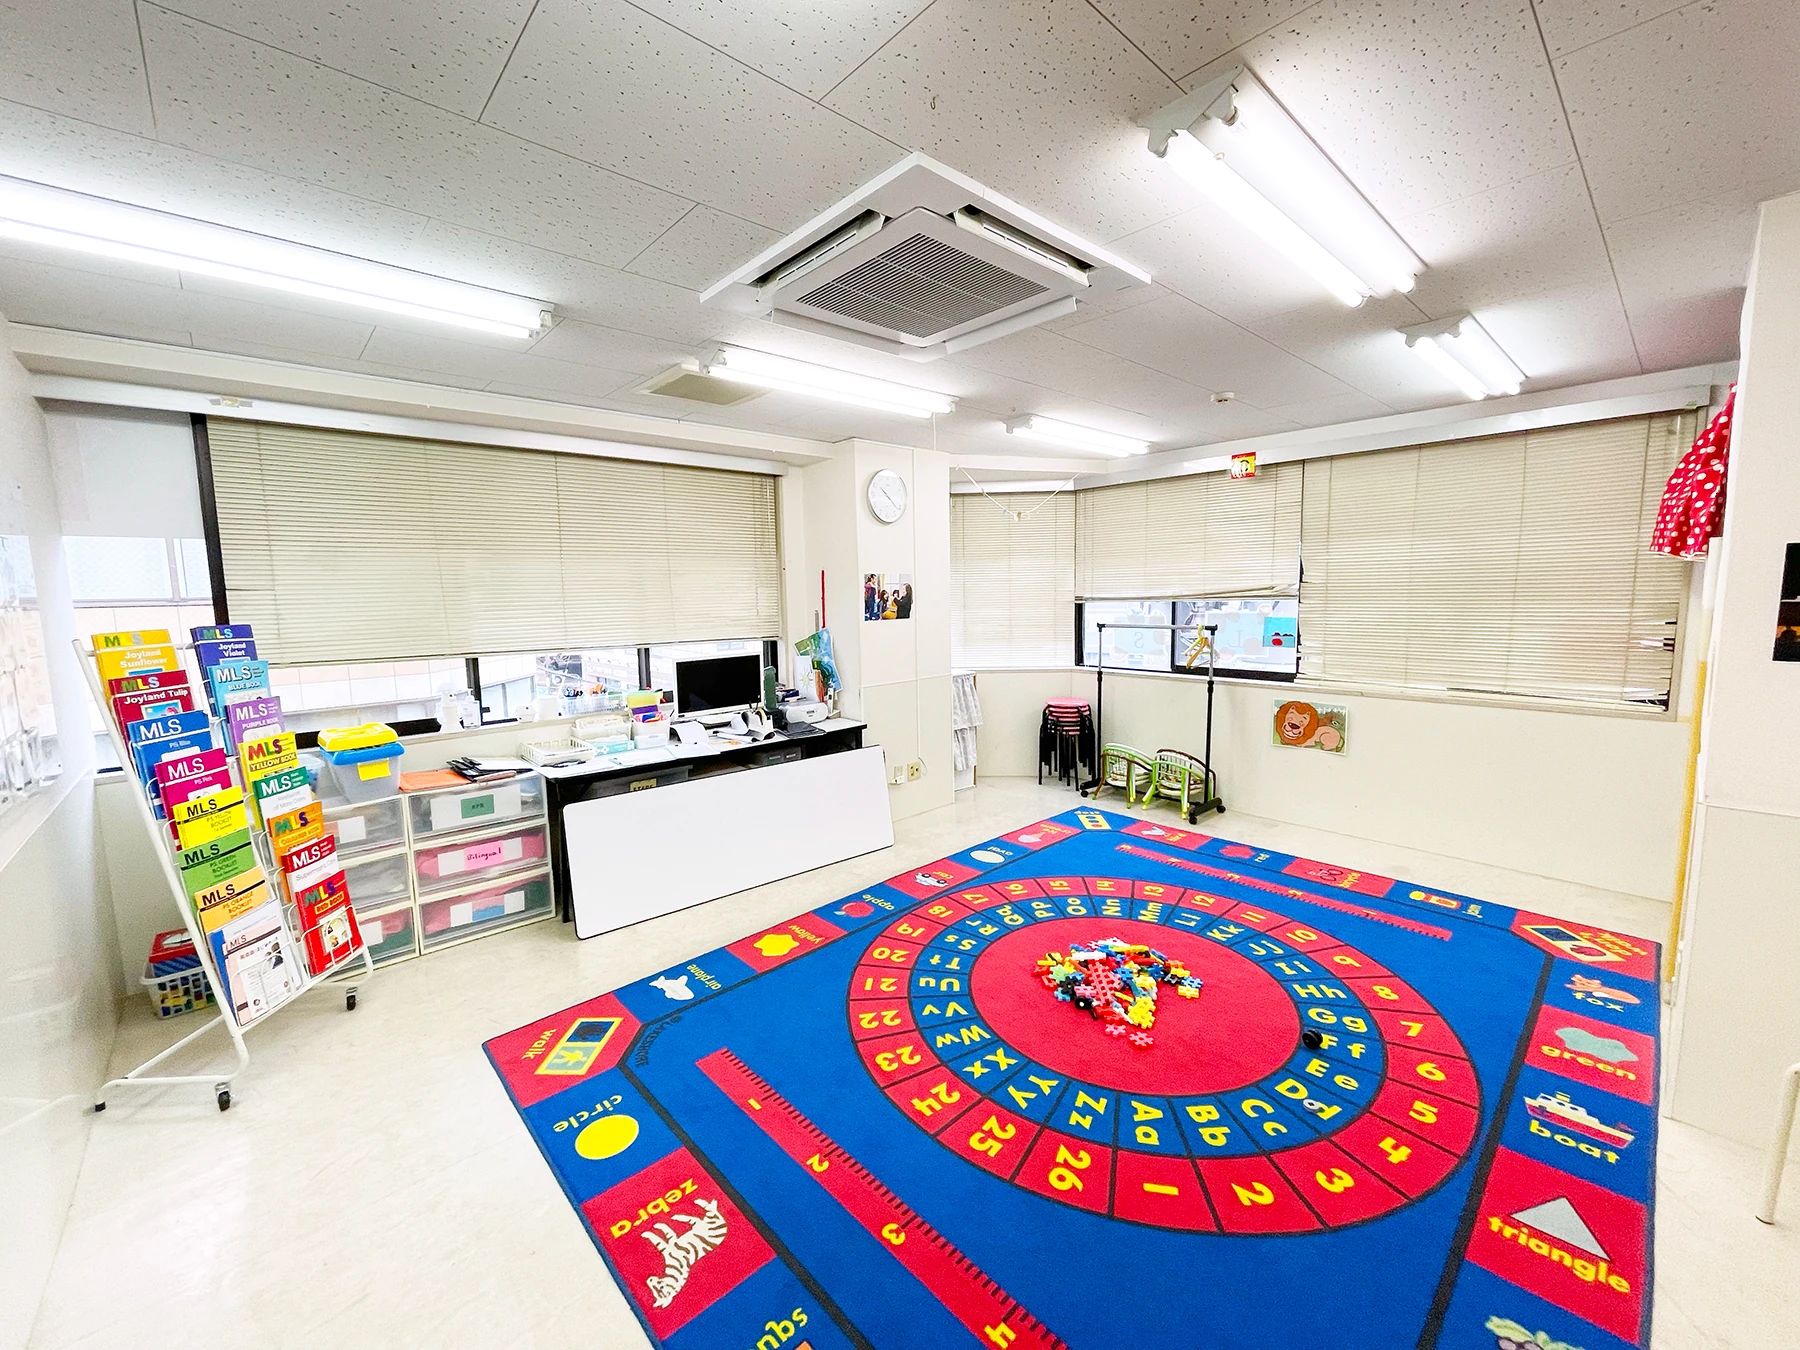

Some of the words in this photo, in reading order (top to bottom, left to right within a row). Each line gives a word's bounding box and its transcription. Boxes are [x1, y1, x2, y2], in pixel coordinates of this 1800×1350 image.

[203, 628, 233, 639] MLS
[121, 676, 160, 692] MLS
[216, 665, 252, 683] MLS
[123, 691, 166, 705] Joyland
[168, 689, 188, 698] Tulip
[236, 704, 268, 722] MLS
[139, 718, 182, 741] MLS
[247, 739, 283, 761] MLS
[167, 757, 205, 780] MLS
[250, 757, 278, 771] YELLOW
[278, 752, 296, 764] BOOK
[260, 775, 292, 797] MLS
[187, 799, 218, 818] MLS
[274, 811, 310, 834] MLS
[183, 844, 221, 866] MLS
[291, 845, 321, 870] MLS
[202, 883, 236, 906] MLS
[304, 880, 336, 908] MLS
[1004, 883, 1028, 895] 16
[1048, 880, 1071, 891] 15
[1096, 880, 1116, 891] 14
[1143, 885, 1165, 897] 13
[862, 893, 895, 911] apple
[962, 893, 989, 905] 17
[1031, 901, 1053, 918] Pp
[1067, 897, 1087, 916] Oo
[1102, 898, 1121, 916] Nn
[1191, 894, 1216, 907] 12
[928, 905, 954, 918] 18
[996, 904, 1024, 925] Qq
[1137, 902, 1163, 923] Mm
[1240, 911, 1266, 923] 11
[787, 924, 823, 945] yellow
[896, 922, 925, 937] 19
[966, 920, 998, 936] Rr
[1207, 925, 1242, 941] Kk
[1286, 929, 1318, 943] 10
[945, 934, 976, 951] Ss
[1250, 941, 1284, 956] Jj
[872, 947, 910, 963] 20
[930, 954, 960, 970] Tt
[1332, 955, 1362, 967] 9
[688, 964, 722, 991] airplane
[1275, 961, 1310, 975] Ii
[864, 977, 898, 992] 21
[919, 977, 960, 992] Uu
[1293, 984, 1346, 999] Hh
[1372, 985, 1399, 1000] 8
[922, 1001, 967, 1017] Vv
[1572, 991, 1625, 1013] fox
[858, 1009, 902, 1029] 22
[1307, 1007, 1368, 1033] Gg
[1400, 1020, 1425, 1037] 7
[520, 1028, 558, 1060] walk
[936, 1024, 990, 1048] Ww
[1319, 1033, 1365, 1059] Ff
[875, 1045, 922, 1072] 23
[964, 1047, 1017, 1079] Xx
[1540, 1045, 1638, 1082] green
[1305, 1058, 1359, 1090] Ee
[1416, 1062, 1446, 1081] 6
[910, 1081, 961, 1117] 24
[1007, 1075, 1058, 1109] Yy
[552, 1095, 623, 1134] circle
[1069, 1090, 1108, 1129] Zz
[1241, 1098, 1288, 1136] Cc
[1408, 1100, 1438, 1124] 5
[1131, 1100, 1164, 1145] Aa
[1185, 1104, 1231, 1147] Bb
[969, 1115, 1016, 1157] 25
[1528, 1119, 1621, 1166] boat
[1378, 1137, 1412, 1164] 4
[806, 1153, 829, 1173] 2
[1048, 1144, 1091, 1191] 26
[1143, 1183, 1179, 1196] 1
[1315, 1168, 1355, 1193] 3
[1231, 1181, 1274, 1206] 2
[609, 1177, 699, 1239] zebra
[881, 1223, 906, 1245] 3
[1488, 1216, 1631, 1294] triangle
[984, 1322, 1016, 1349] 4
